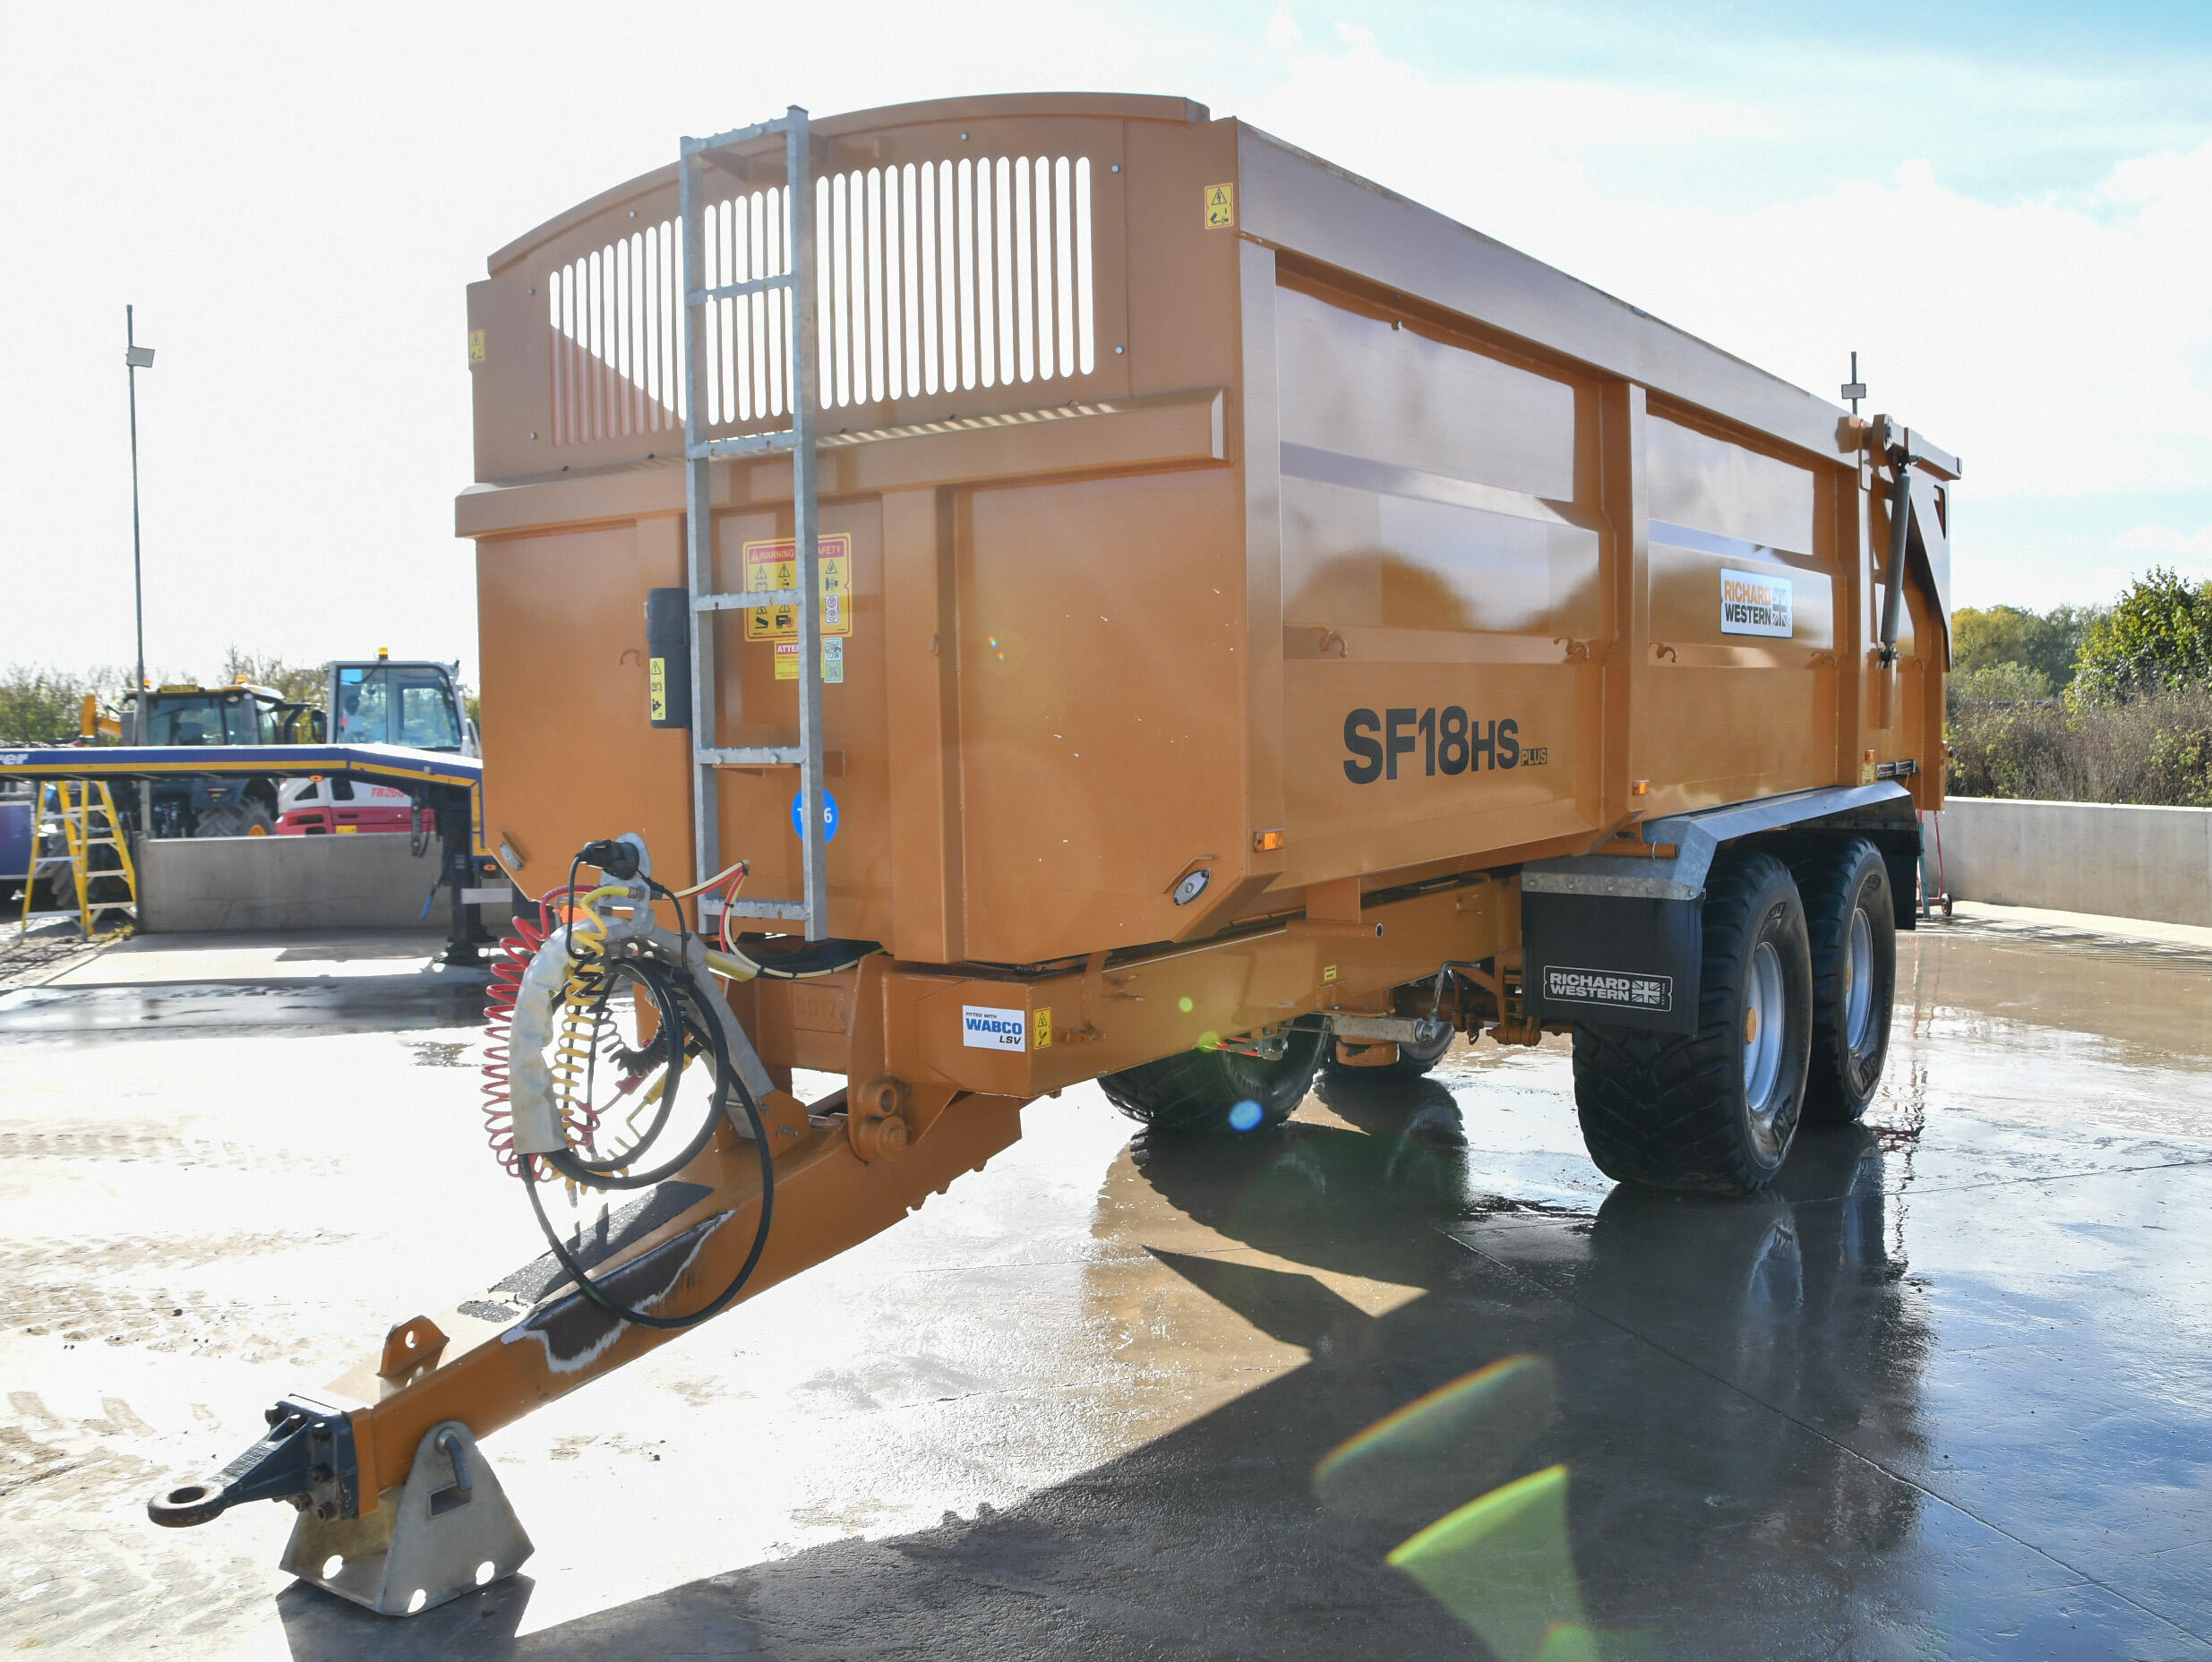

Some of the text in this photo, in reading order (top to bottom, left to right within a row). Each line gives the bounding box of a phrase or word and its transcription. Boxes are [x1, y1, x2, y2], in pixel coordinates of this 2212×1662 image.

[759, 545, 841, 560] WARNING AFETY
[1724, 580, 1771, 605] RICHARD
[1725, 604, 1771, 625] WESTERN
[1522, 748, 1548, 767] PLUS
[1550, 972, 1630, 990] RICHARD
[1551, 984, 1630, 1001] WESTERN
[965, 1018, 1022, 1035] WABCO
[999, 1035, 1021, 1045] LSV
